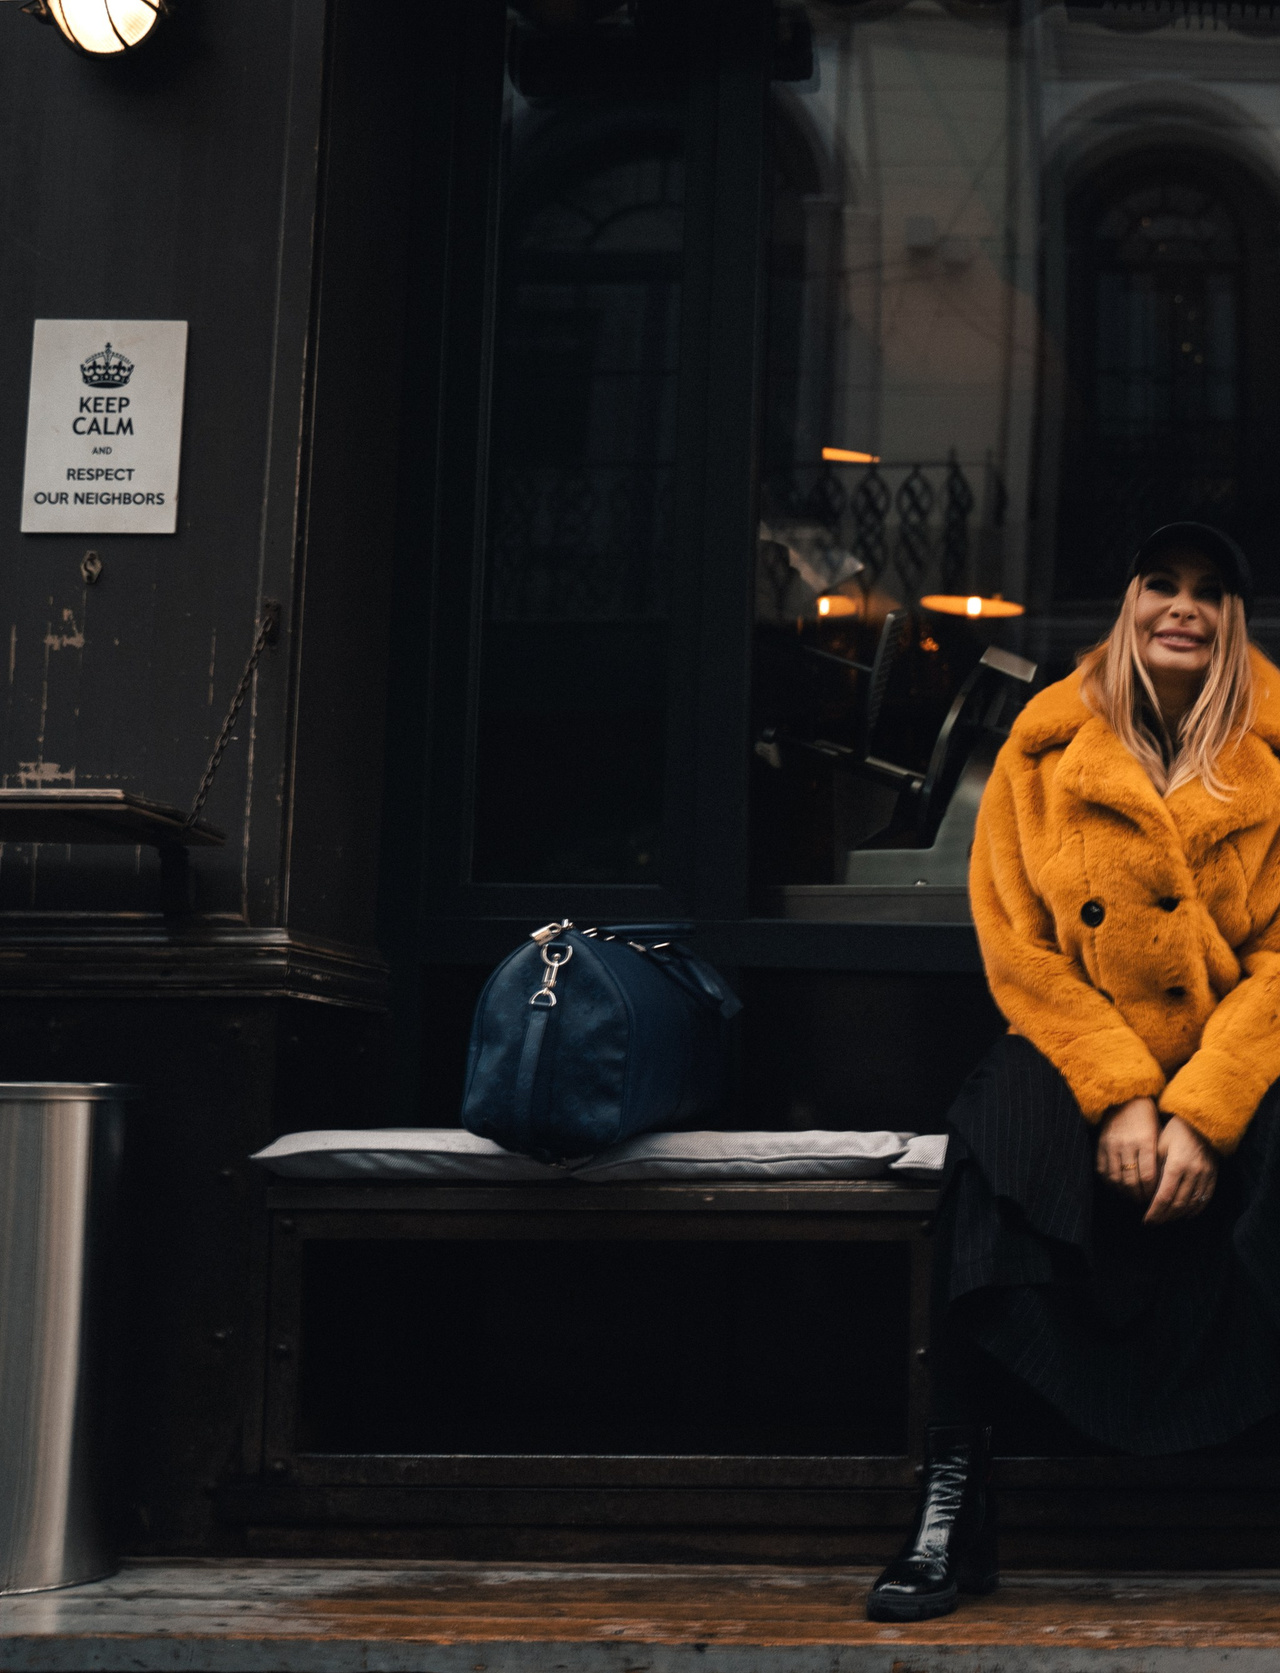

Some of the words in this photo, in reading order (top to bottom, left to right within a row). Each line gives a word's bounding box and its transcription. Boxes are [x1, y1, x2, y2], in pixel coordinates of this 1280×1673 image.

[79, 397, 130, 413] KEEP
[72, 417, 134, 435] CALM
[92, 447, 112, 455] AND
[66, 468, 135, 481] RESPECT
[34, 492, 69, 505] OUR
[74, 492, 166, 505] NEIGHBORS
